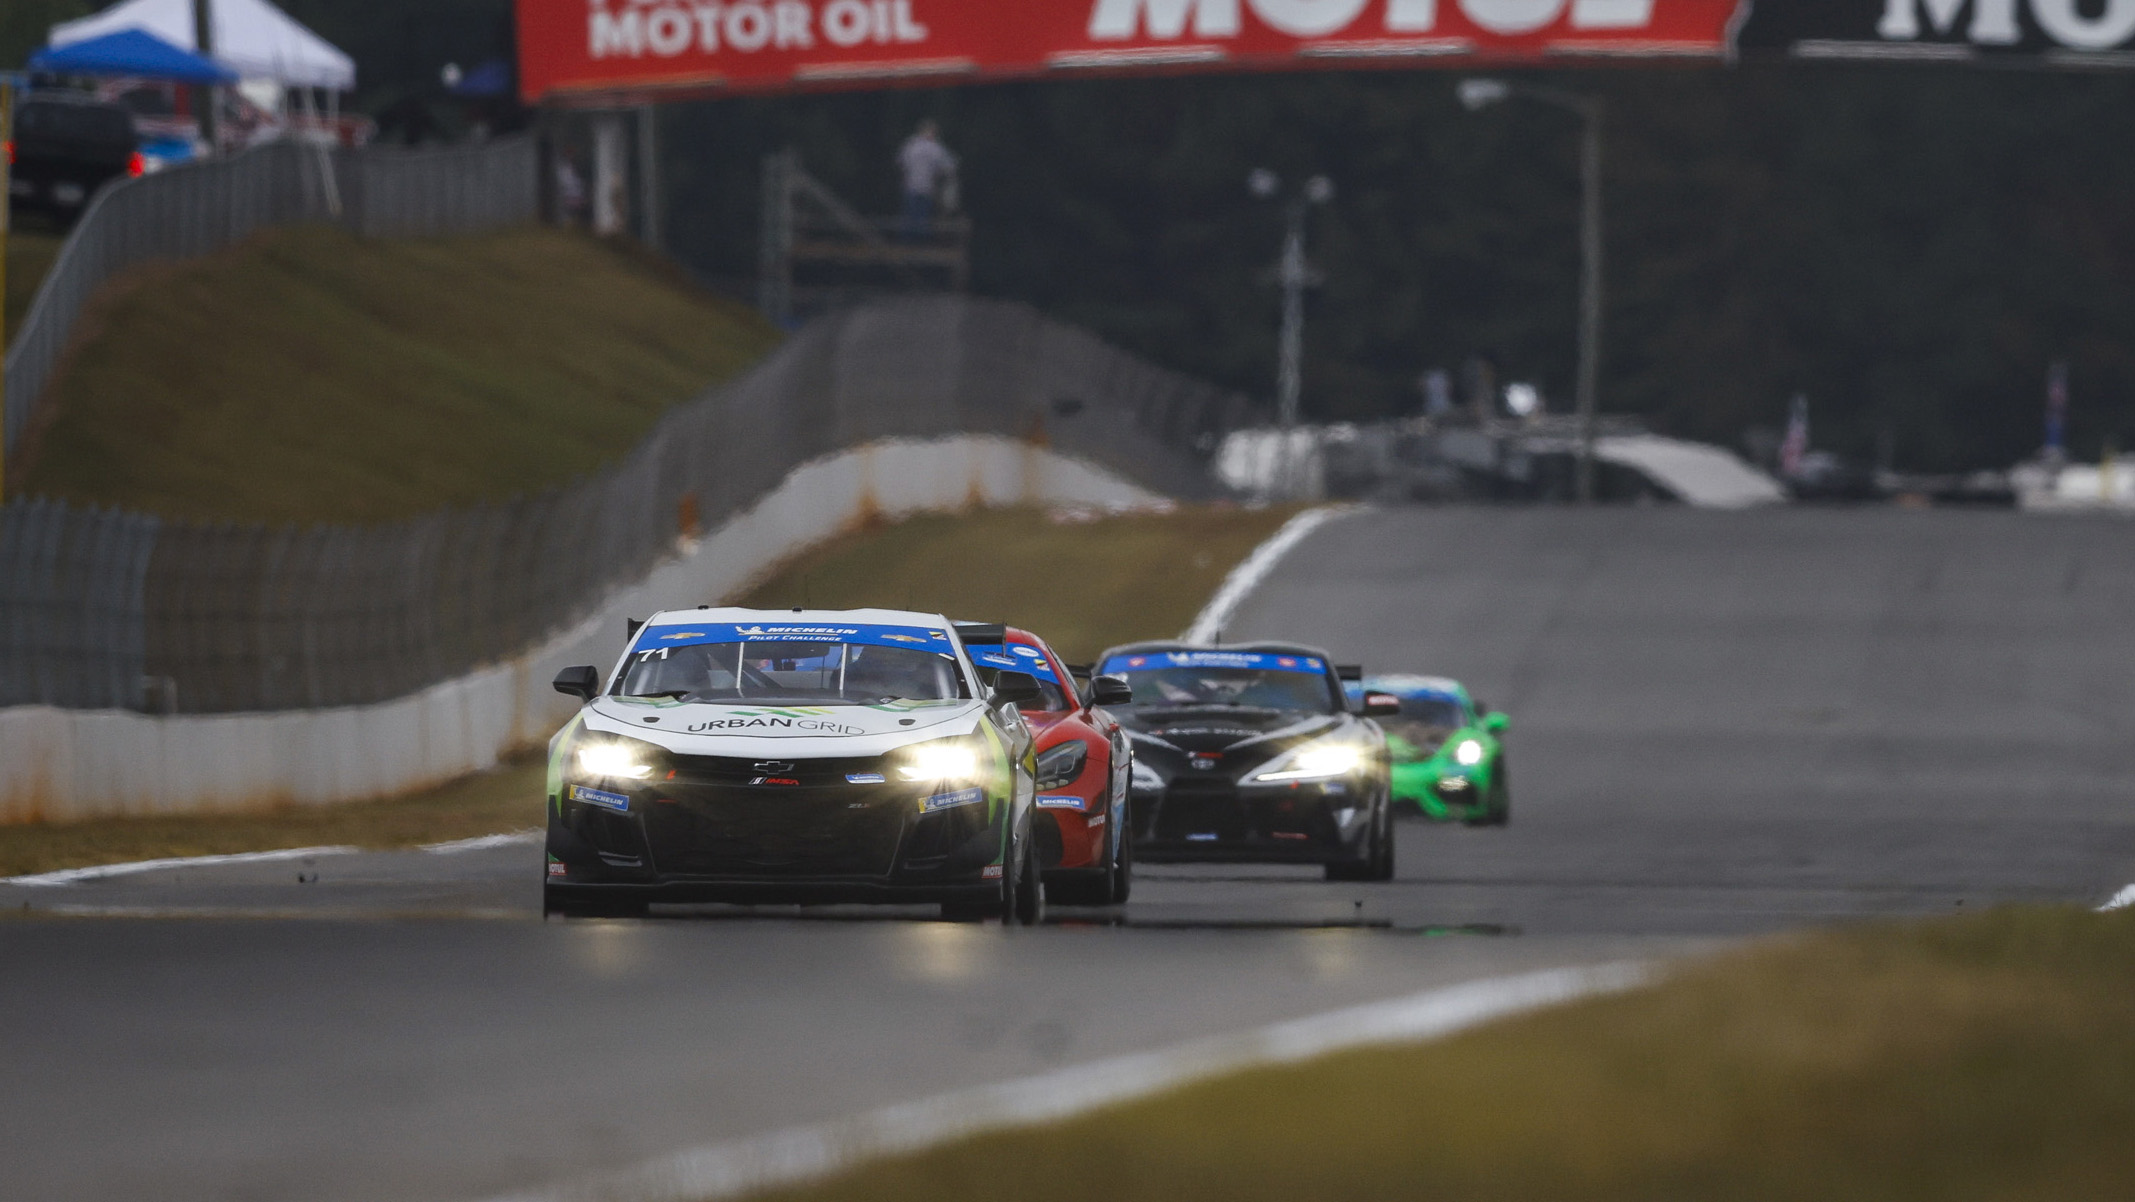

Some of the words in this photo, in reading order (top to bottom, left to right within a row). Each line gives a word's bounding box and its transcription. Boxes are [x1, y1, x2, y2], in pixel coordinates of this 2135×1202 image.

[588, 0, 815, 60] MOTOR
[819, 0, 930, 48] OIL
[767, 627, 858, 635] MICHELIN
[638, 647, 669, 662] 71
[585, 792, 624, 806] MICHELIN
[936, 791, 977, 806] MICHELIN
[1042, 798, 1081, 806] MICHELIN
